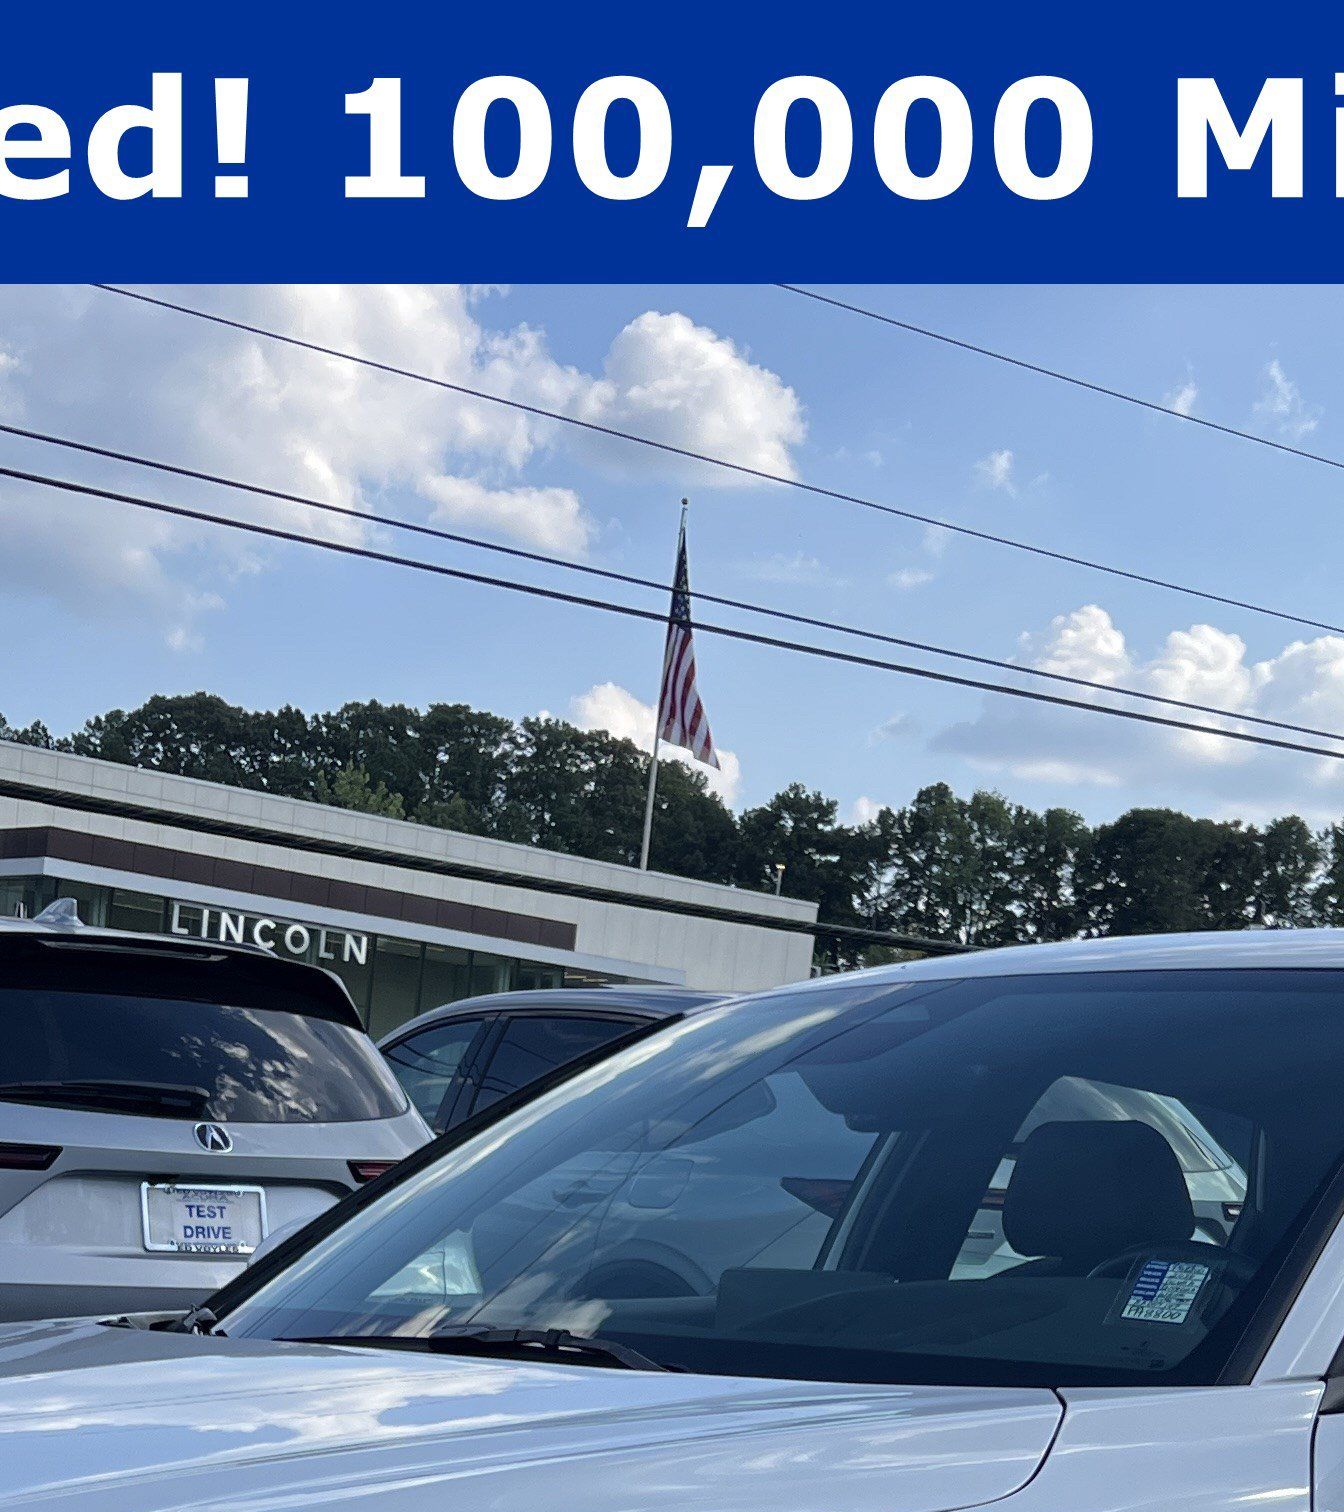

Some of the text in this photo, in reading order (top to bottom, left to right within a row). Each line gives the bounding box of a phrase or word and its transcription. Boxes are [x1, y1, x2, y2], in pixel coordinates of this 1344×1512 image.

[172, 902, 368, 965] LINCOLN
[185, 1204, 227, 1219] TEST
[183, 1225, 232, 1239] DRIVE
